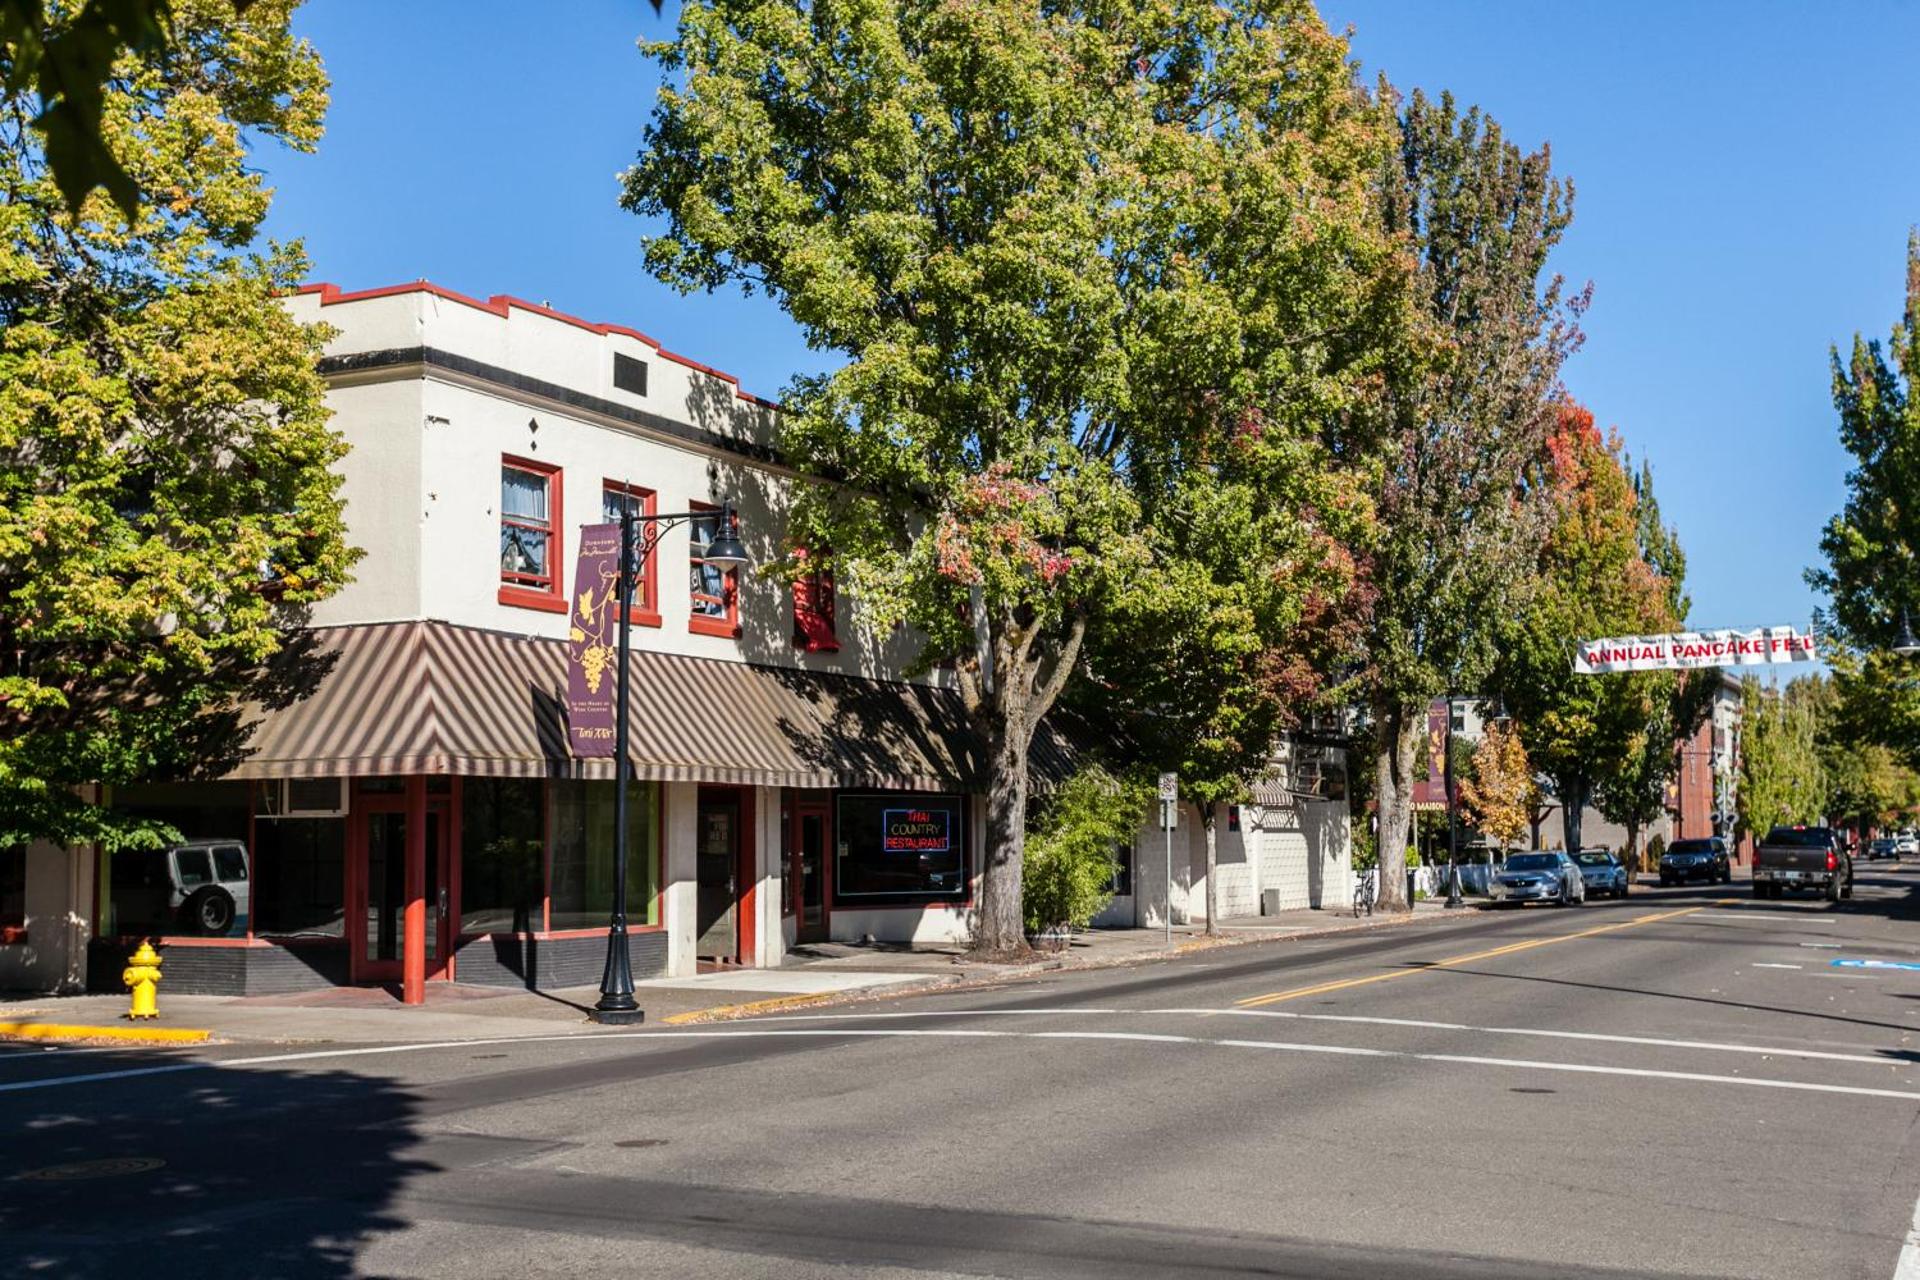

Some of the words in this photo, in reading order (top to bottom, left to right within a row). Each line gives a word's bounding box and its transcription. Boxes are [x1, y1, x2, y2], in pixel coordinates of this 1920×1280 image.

[1588, 645, 1666, 663] ANNUAL
[1672, 639, 1765, 657] PANCAKE
[1416, 801, 1446, 811] MAISON
[908, 812, 930, 822] THAI
[891, 823, 941, 835] COUNTRY
[886, 837, 948, 849] RESTAURANT
